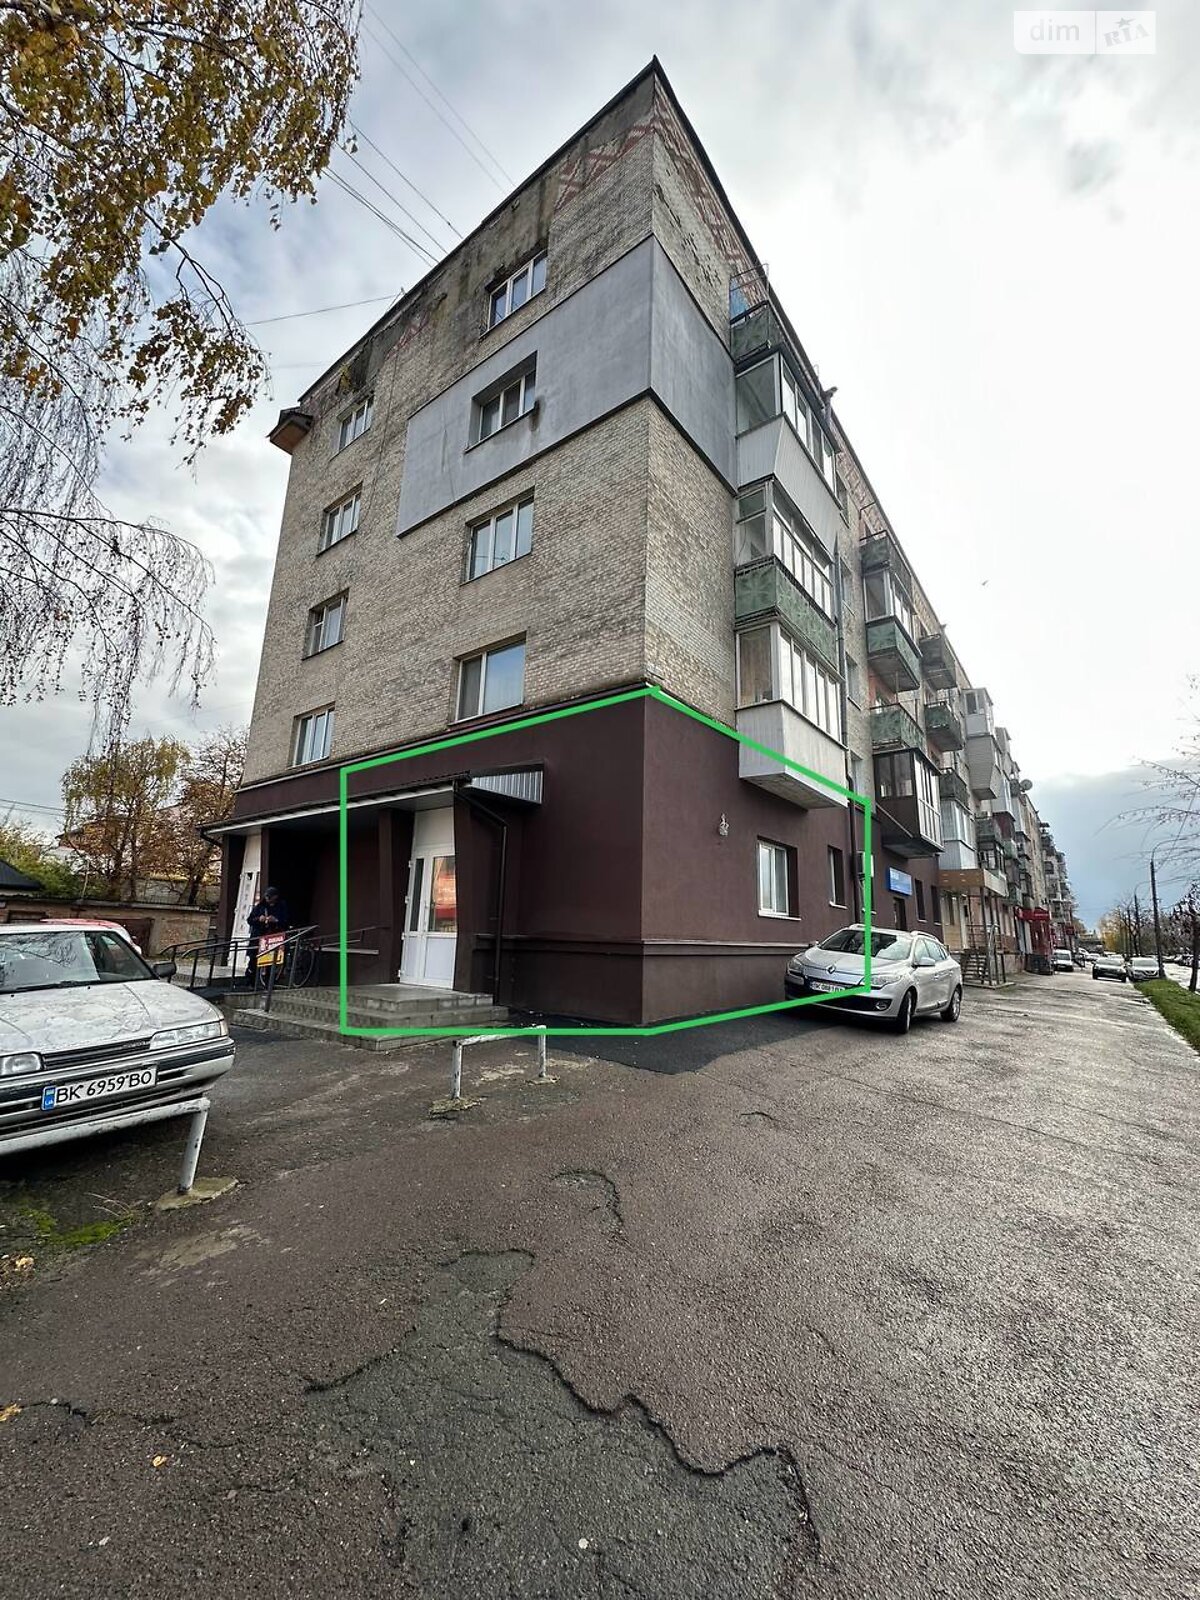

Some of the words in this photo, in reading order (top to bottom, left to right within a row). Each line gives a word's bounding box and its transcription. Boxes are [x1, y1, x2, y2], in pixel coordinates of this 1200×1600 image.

[56, 1085, 82, 1104] BK
[86, 1075, 125, 1097] 6959
[128, 1070, 152, 1088] BO
